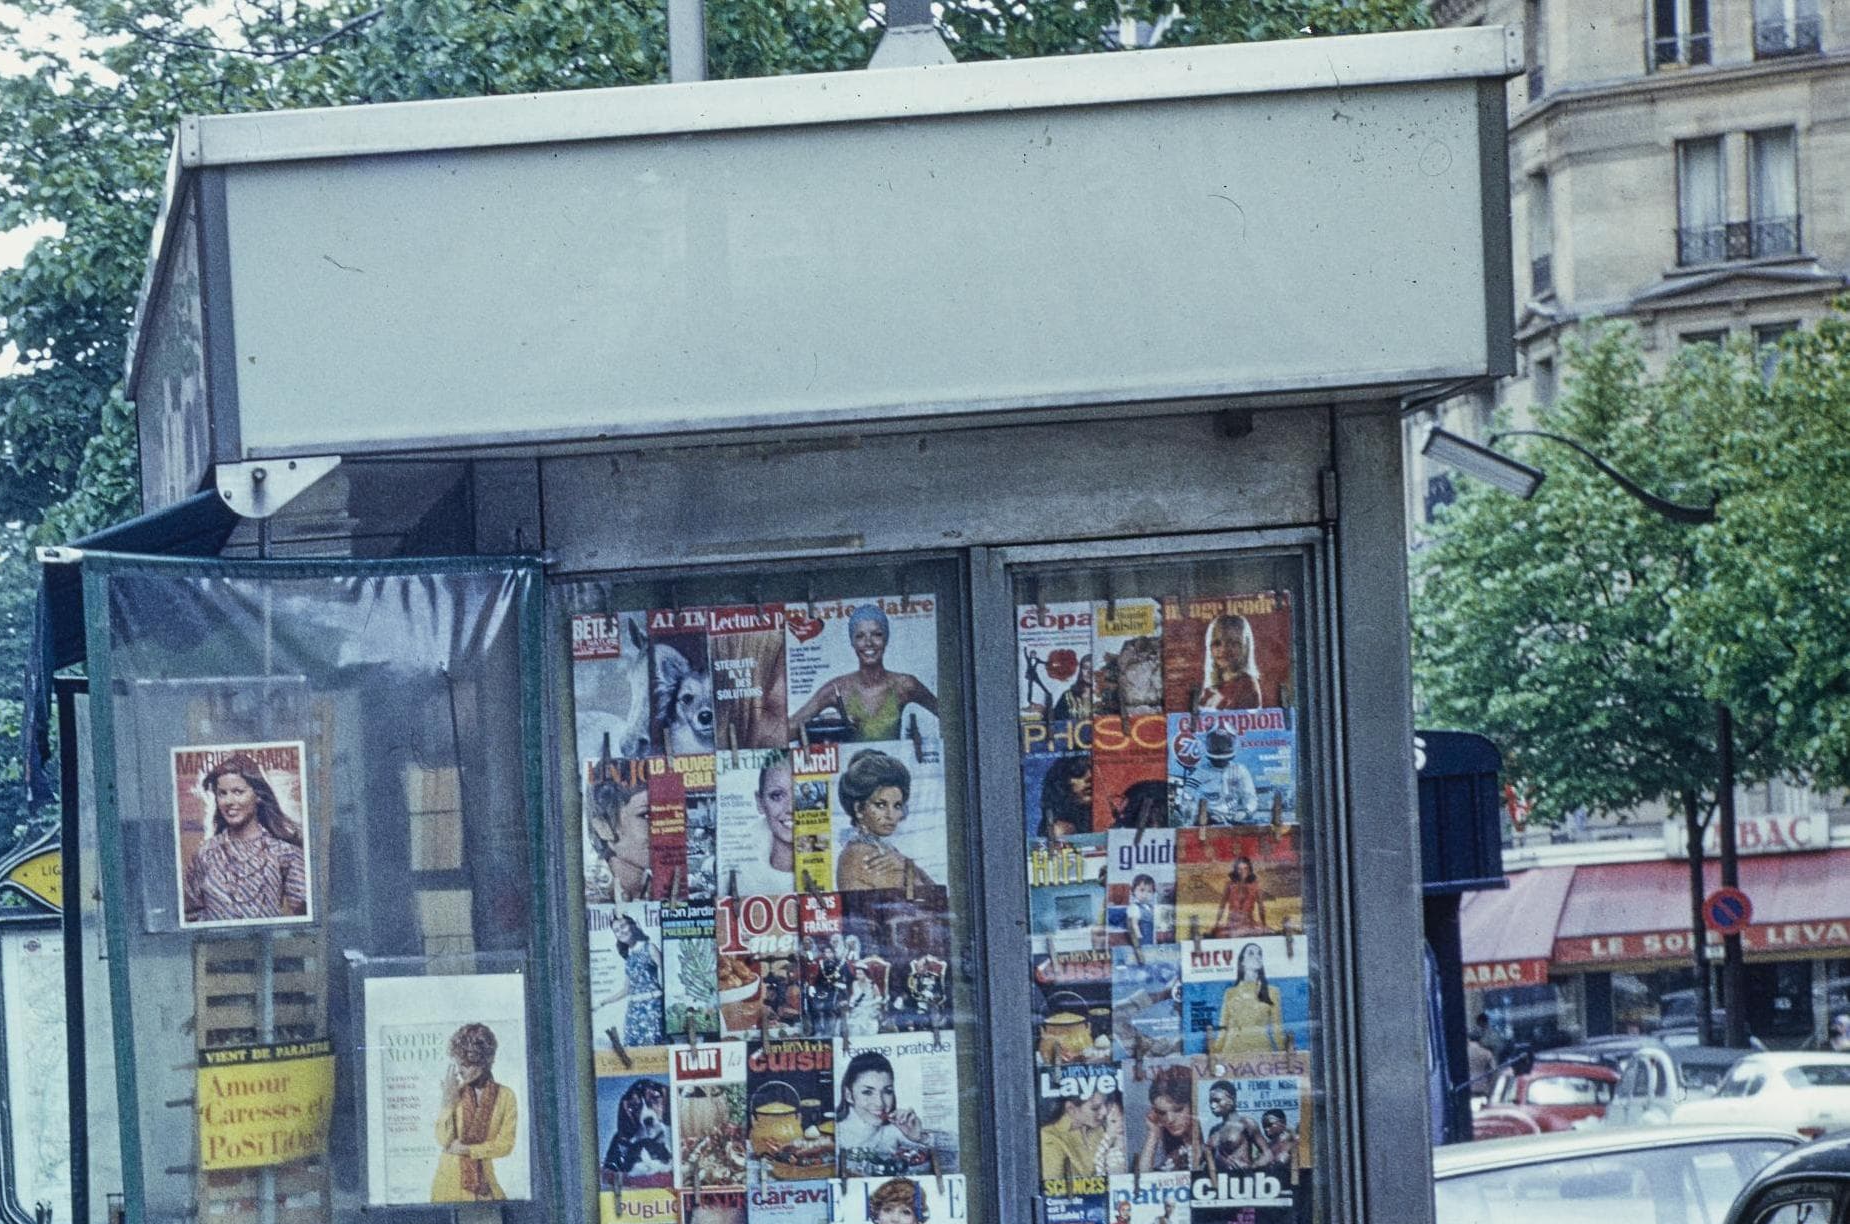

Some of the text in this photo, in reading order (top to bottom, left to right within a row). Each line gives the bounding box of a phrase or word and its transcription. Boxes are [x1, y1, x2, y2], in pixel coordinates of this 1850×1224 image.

[1591, 939, 1621, 956] LE
[1464, 964, 1521, 983] ABAC
[205, 1050, 247, 1063] VIENT
[252, 1048, 271, 1060] DE
[212, 1075, 291, 1098] Amour
[1192, 1172, 1281, 1200] club
